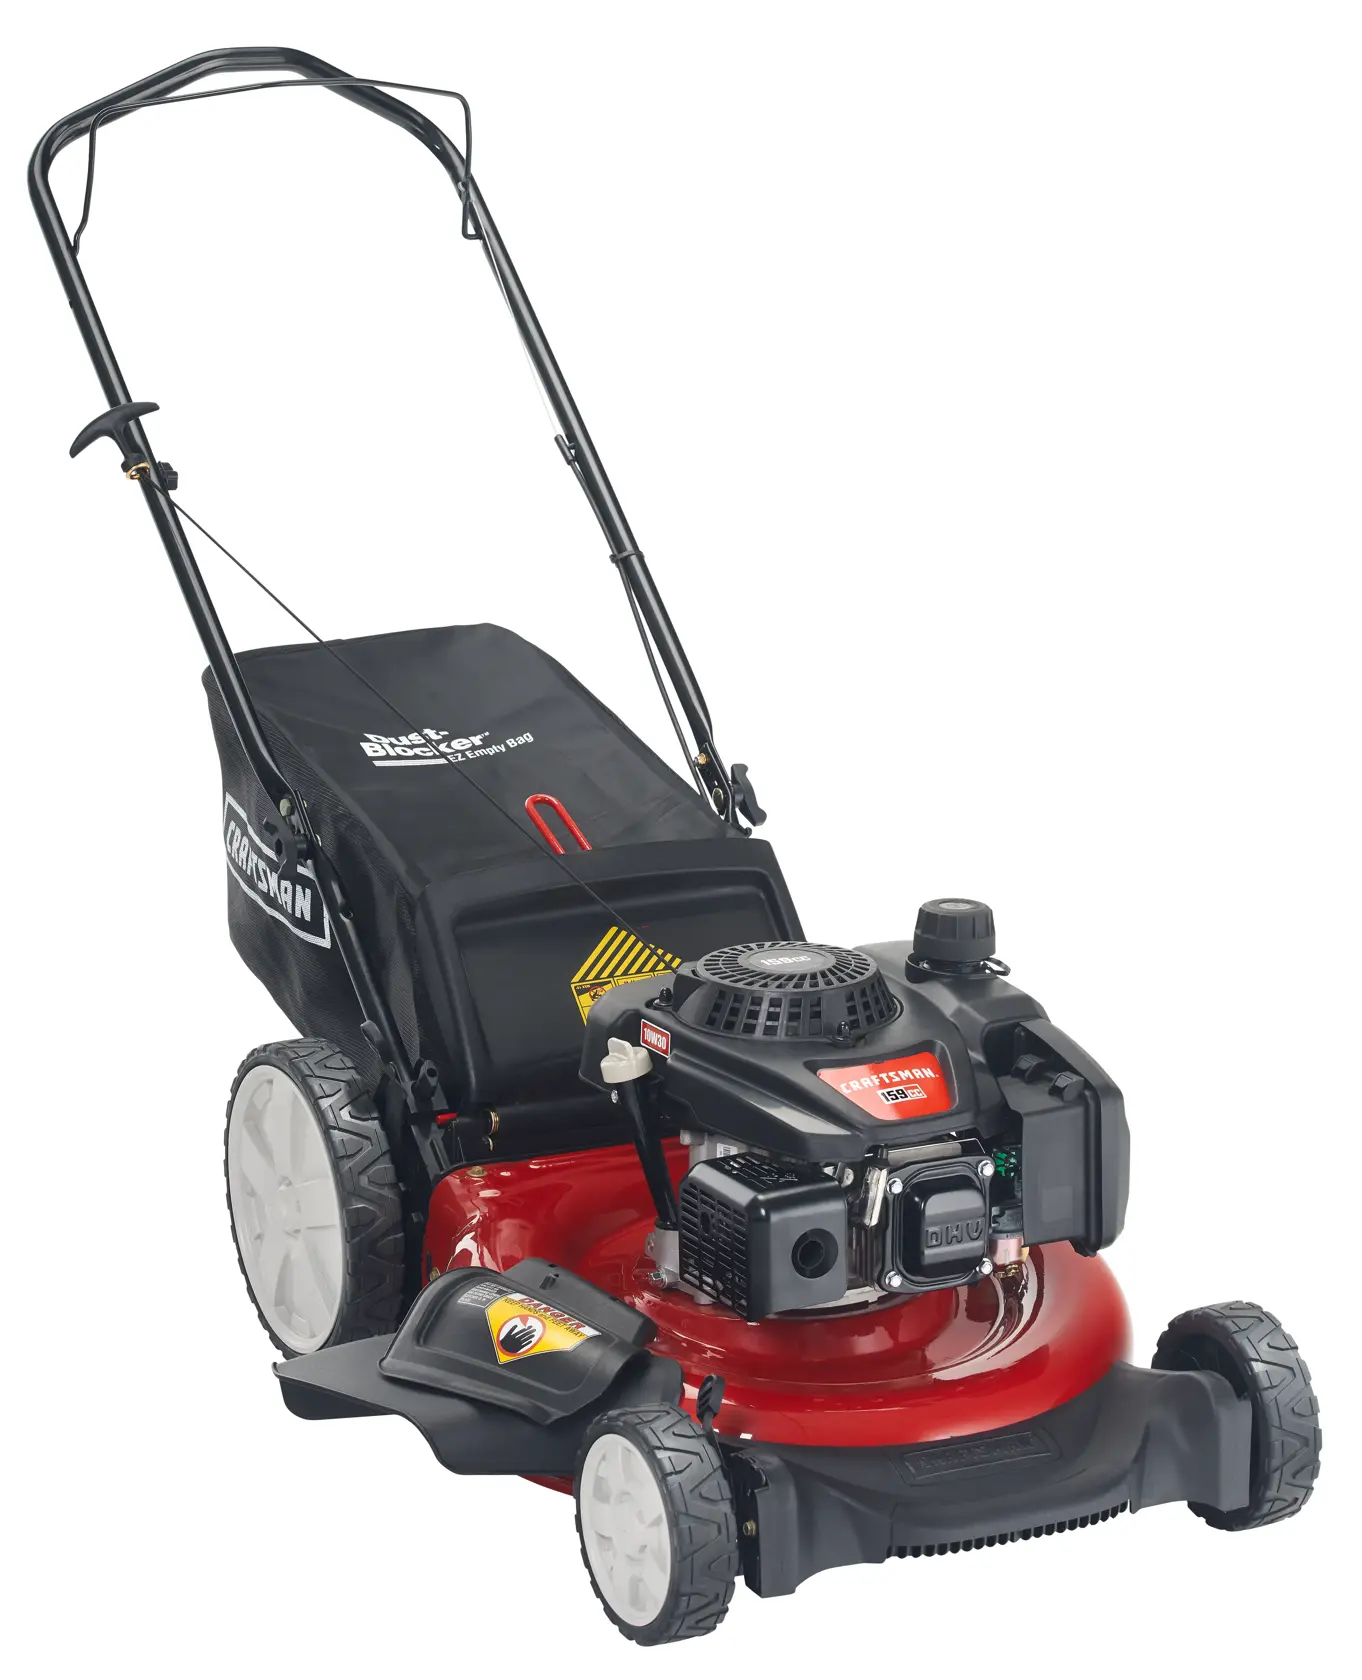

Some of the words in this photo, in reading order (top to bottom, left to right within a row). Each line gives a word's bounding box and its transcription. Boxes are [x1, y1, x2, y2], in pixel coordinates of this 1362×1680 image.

[448, 752, 466, 763] EZ
[465, 743, 507, 760] Empty
[506, 731, 534, 748] Bag
[643, 1027, 667, 1050] 10W30
[518, 1297, 586, 1329] DANGER
[549, 1318, 566, 1329] FEET
[563, 1325, 586, 1338] AWAY
